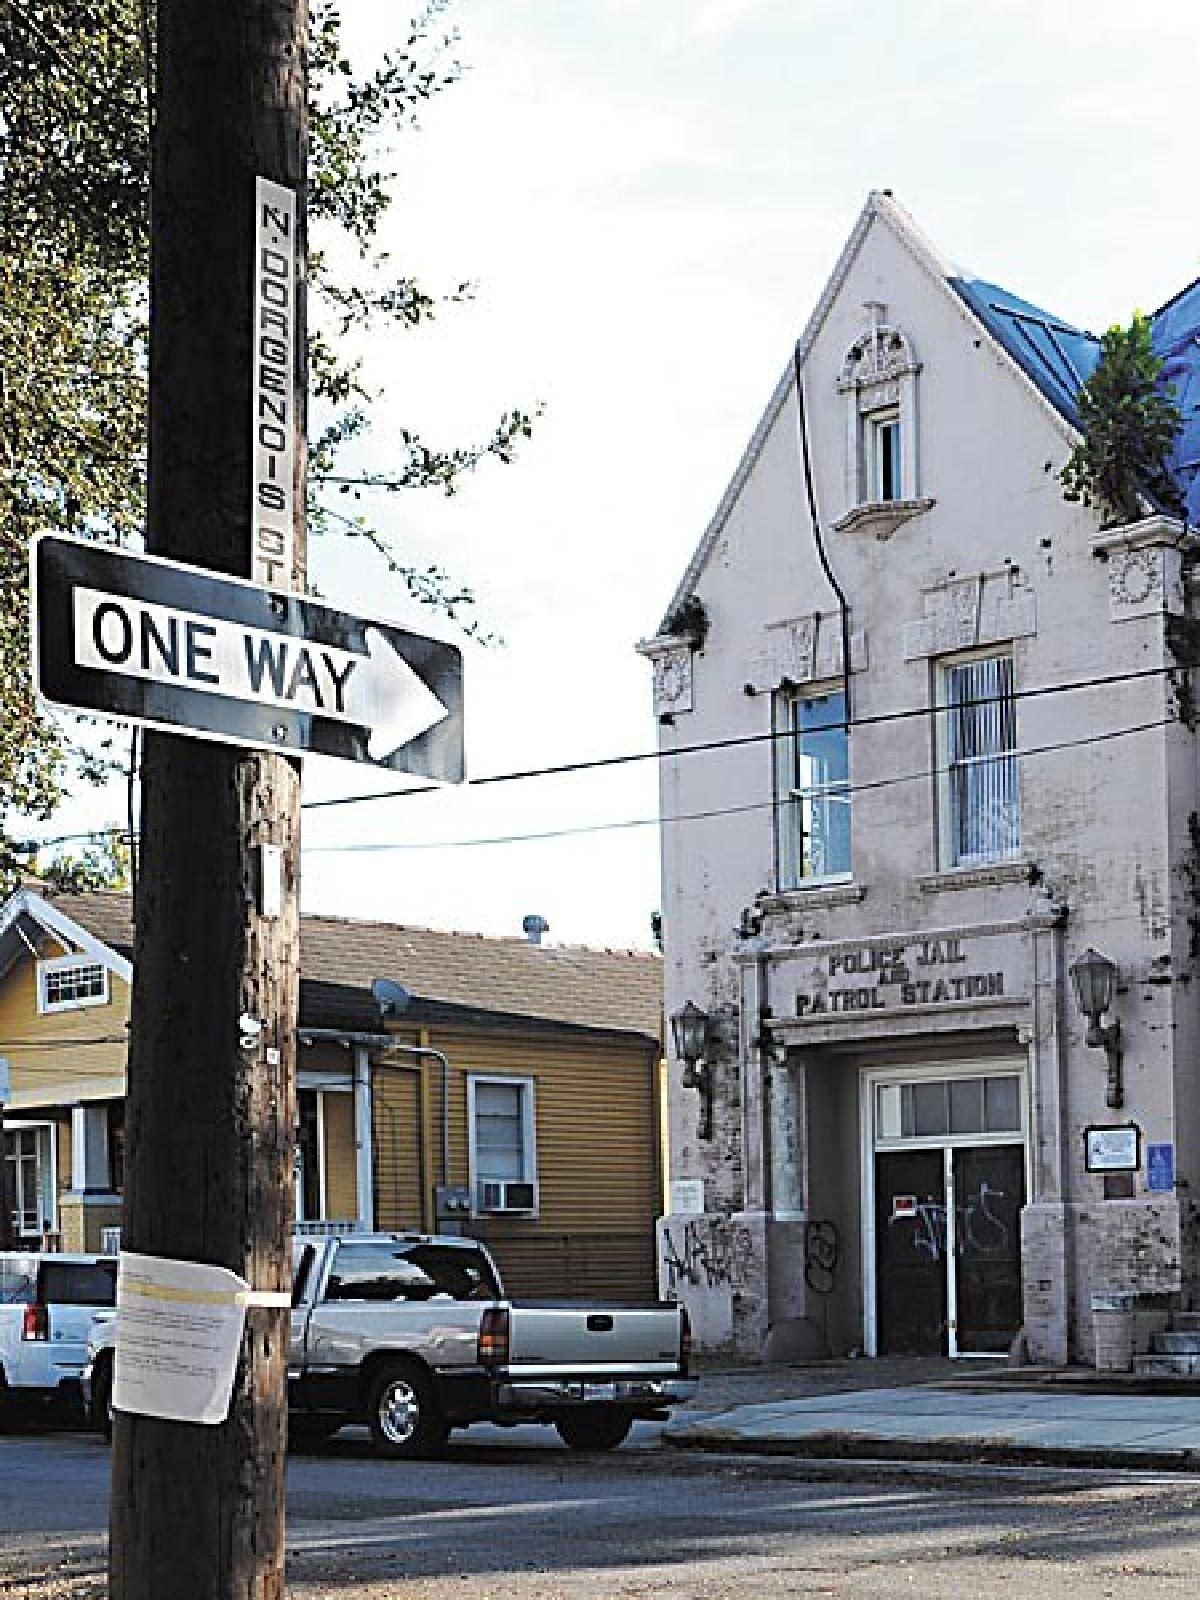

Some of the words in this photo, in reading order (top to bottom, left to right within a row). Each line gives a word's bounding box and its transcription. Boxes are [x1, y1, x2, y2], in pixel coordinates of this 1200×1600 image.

[258, 247, 289, 511] DORGENOIS
[256, 526, 285, 582] ST
[92, 601, 220, 684] ONE
[243, 634, 356, 712] WAY
[828, 947, 905, 977] POLICE
[916, 938, 968, 966] JAIL
[796, 988, 886, 1017] PATROL
[901, 970, 1004, 1004] STATION
